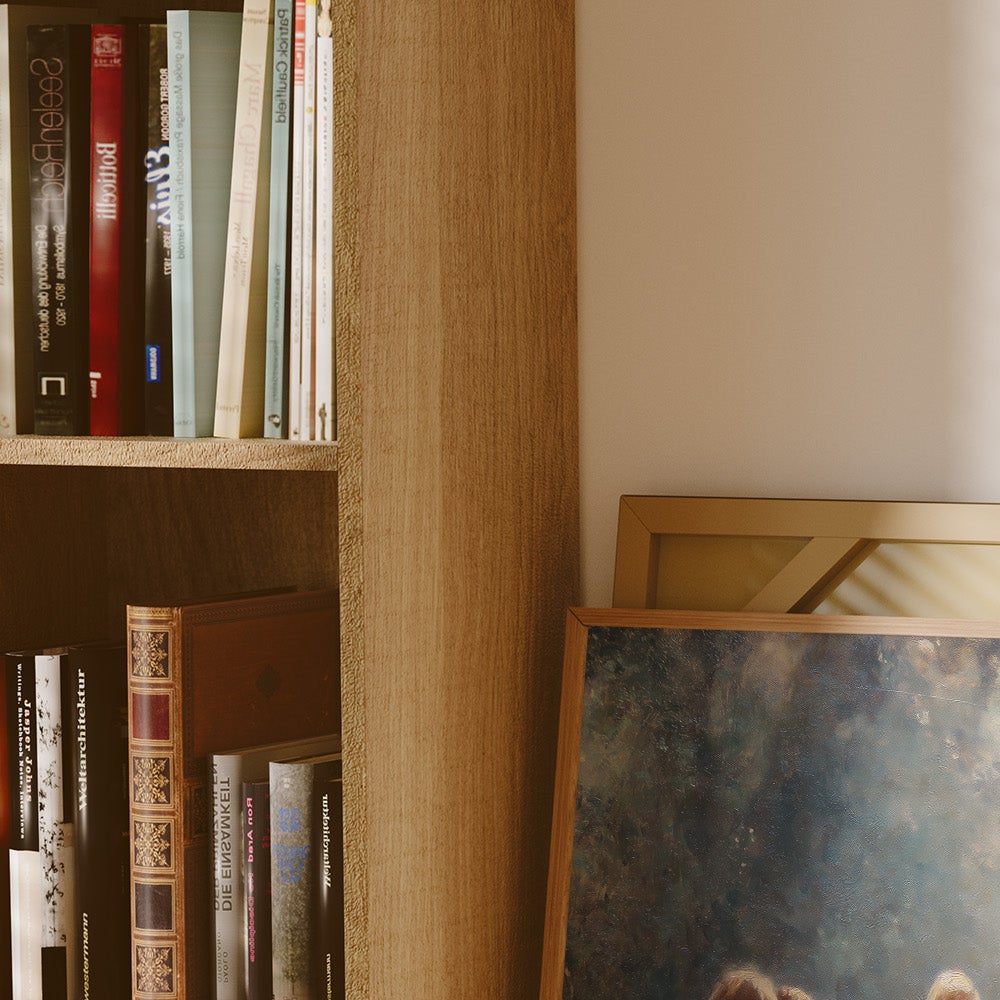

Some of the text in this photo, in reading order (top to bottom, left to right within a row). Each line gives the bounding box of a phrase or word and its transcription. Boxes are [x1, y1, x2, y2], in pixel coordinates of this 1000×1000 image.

[23, 699, 33, 803] Jasper Johns
[77, 668, 88, 812] Weltarchitektur
